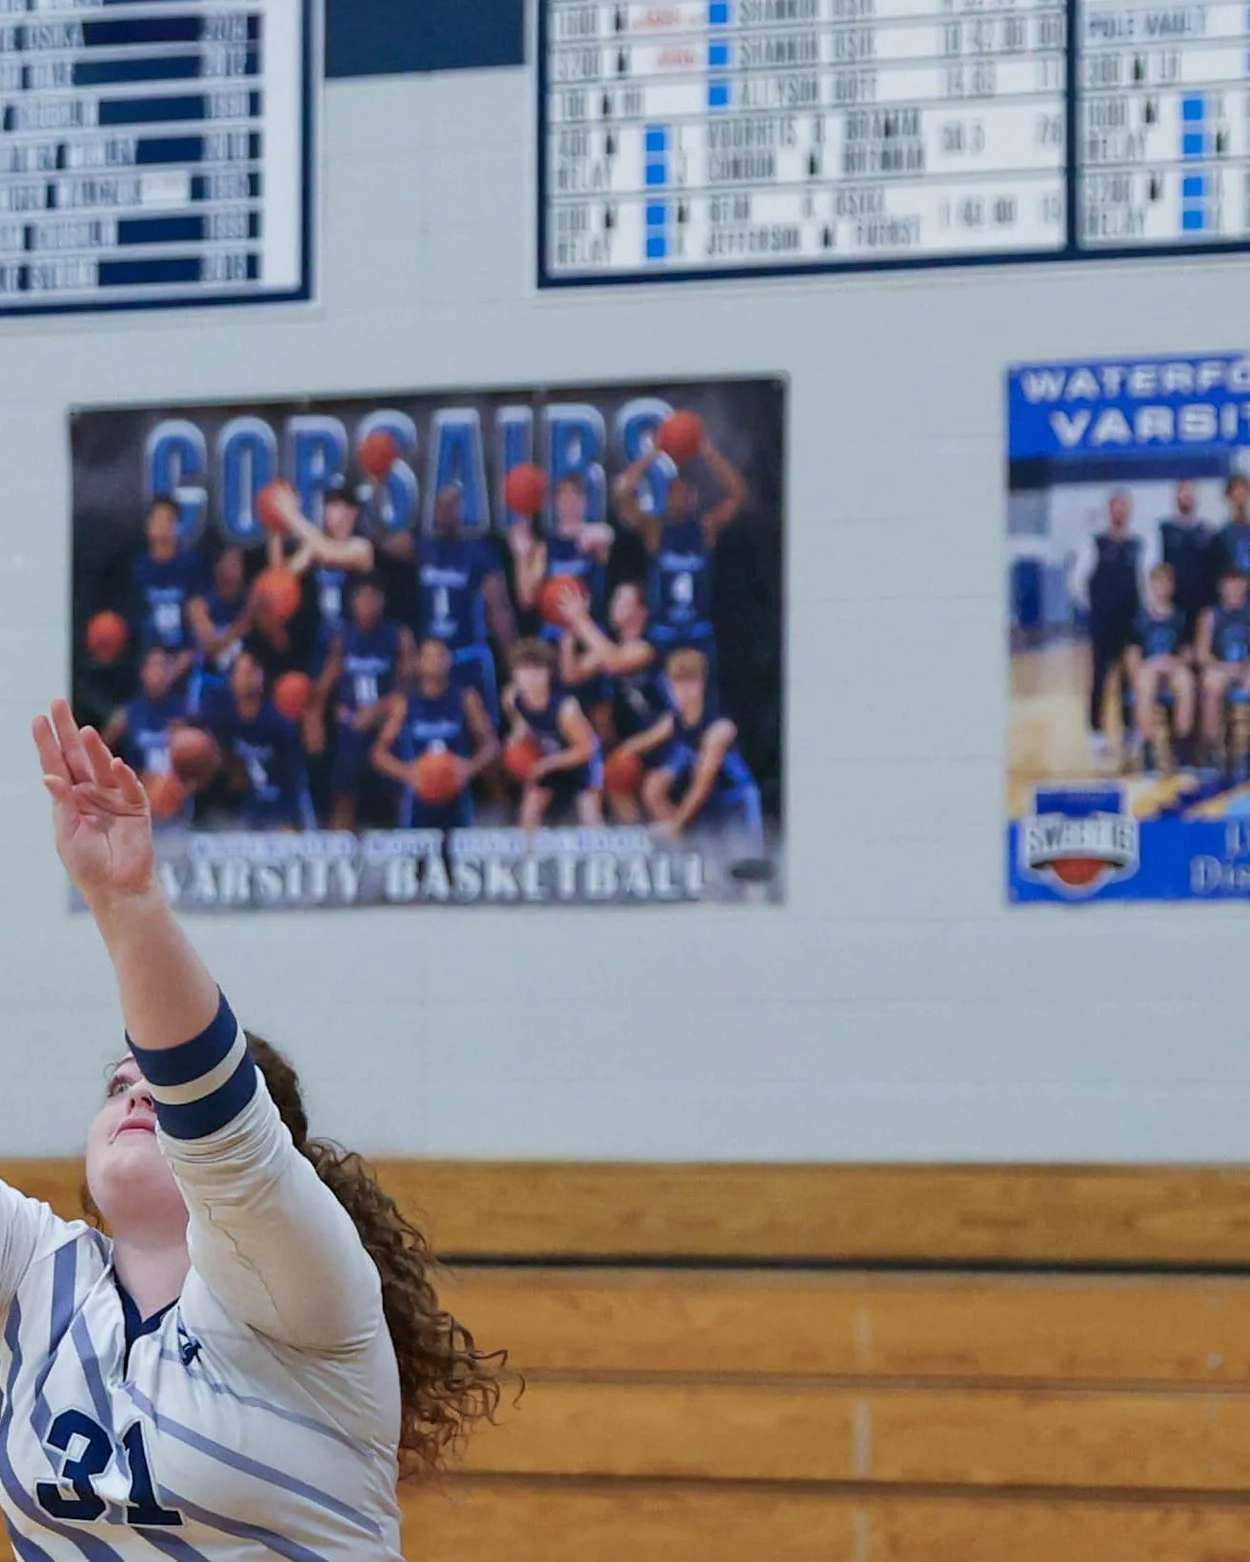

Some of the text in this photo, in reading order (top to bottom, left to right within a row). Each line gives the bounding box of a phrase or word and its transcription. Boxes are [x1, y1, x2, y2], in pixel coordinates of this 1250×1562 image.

[143, 398, 682, 547] CORSAIRS
[159, 852, 705, 902] VARSITY BASKETBALL
[34, 1408, 184, 1527] 31
